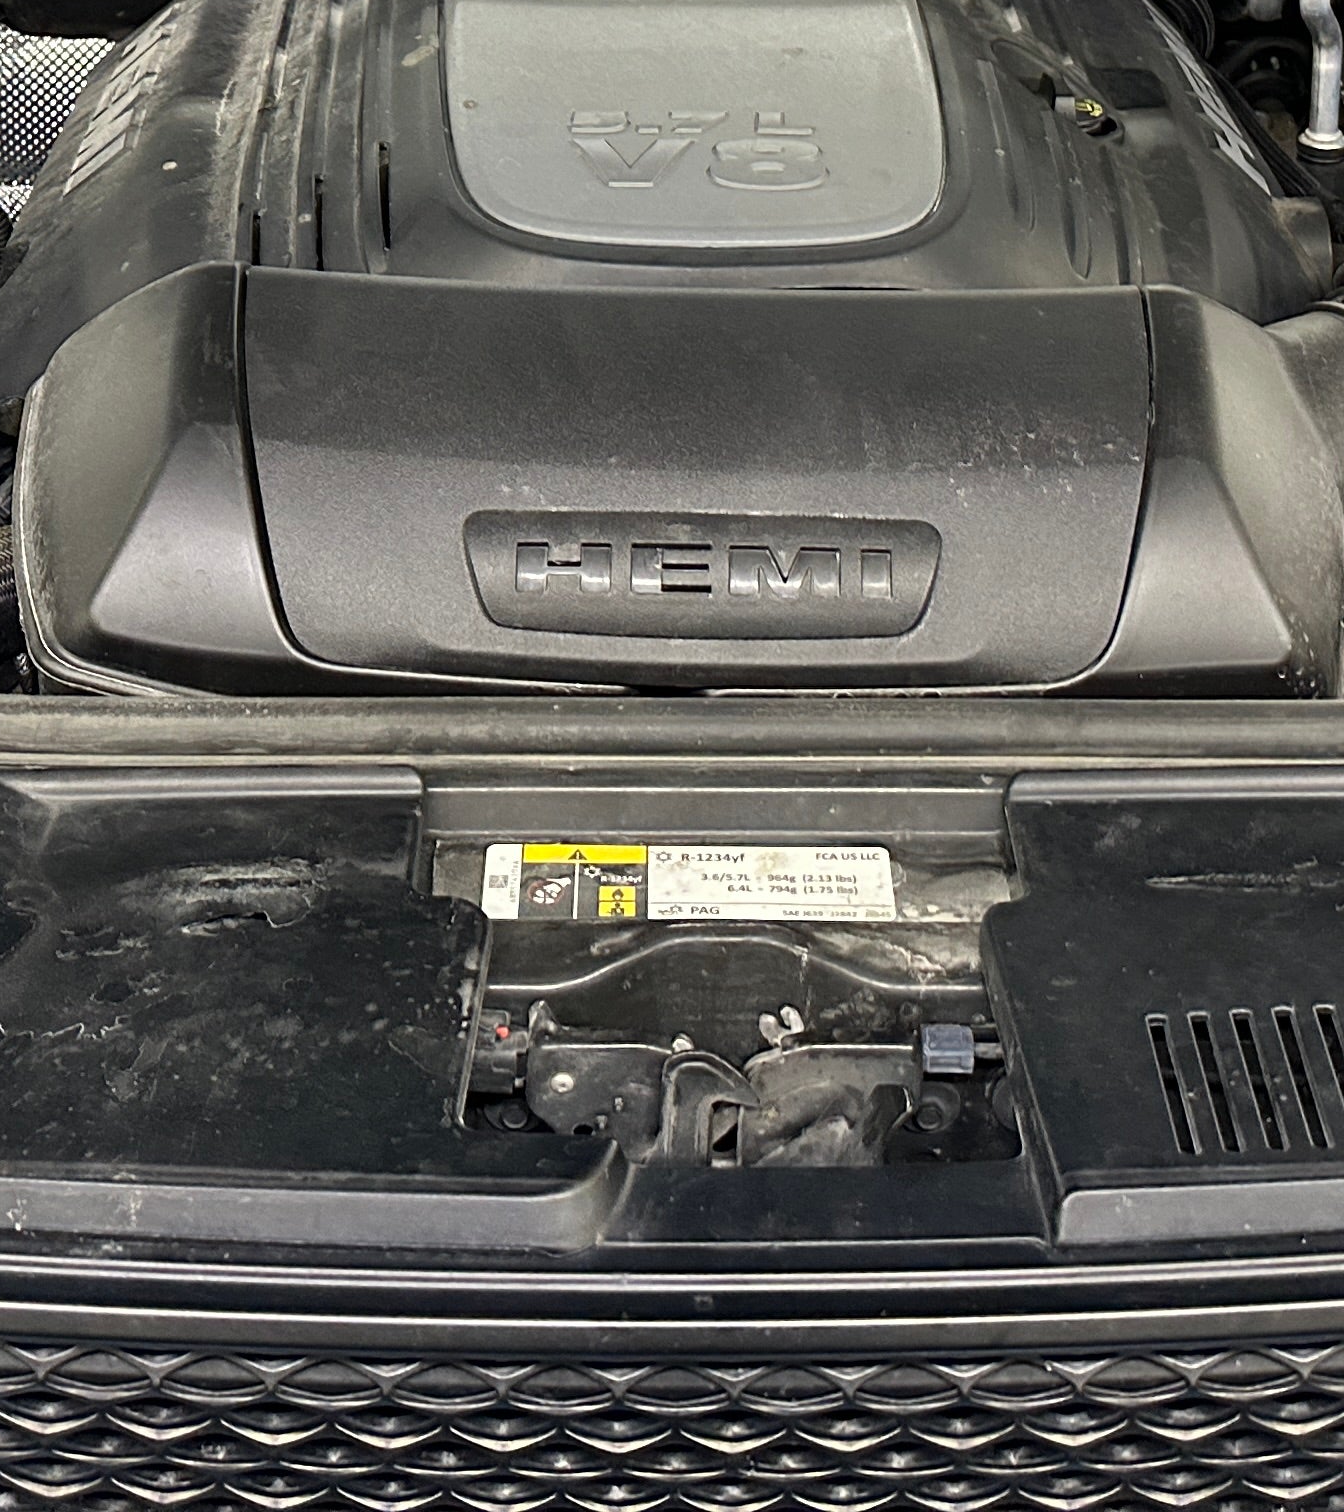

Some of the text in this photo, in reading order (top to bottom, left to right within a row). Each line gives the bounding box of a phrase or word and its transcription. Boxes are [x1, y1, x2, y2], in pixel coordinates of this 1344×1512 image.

[569, 138, 830, 190] V8
[515, 541, 892, 599] HEMI
[681, 853, 745, 863] R-1234yf
[815, 852, 881, 861] FCA US LLC
[701, 873, 751, 882] 3.6/5.7L
[767, 873, 796, 884] 964g
[727, 884, 753, 893] 6.4L
[769, 885, 797, 895] 794g
[690, 906, 720, 915] PAG
